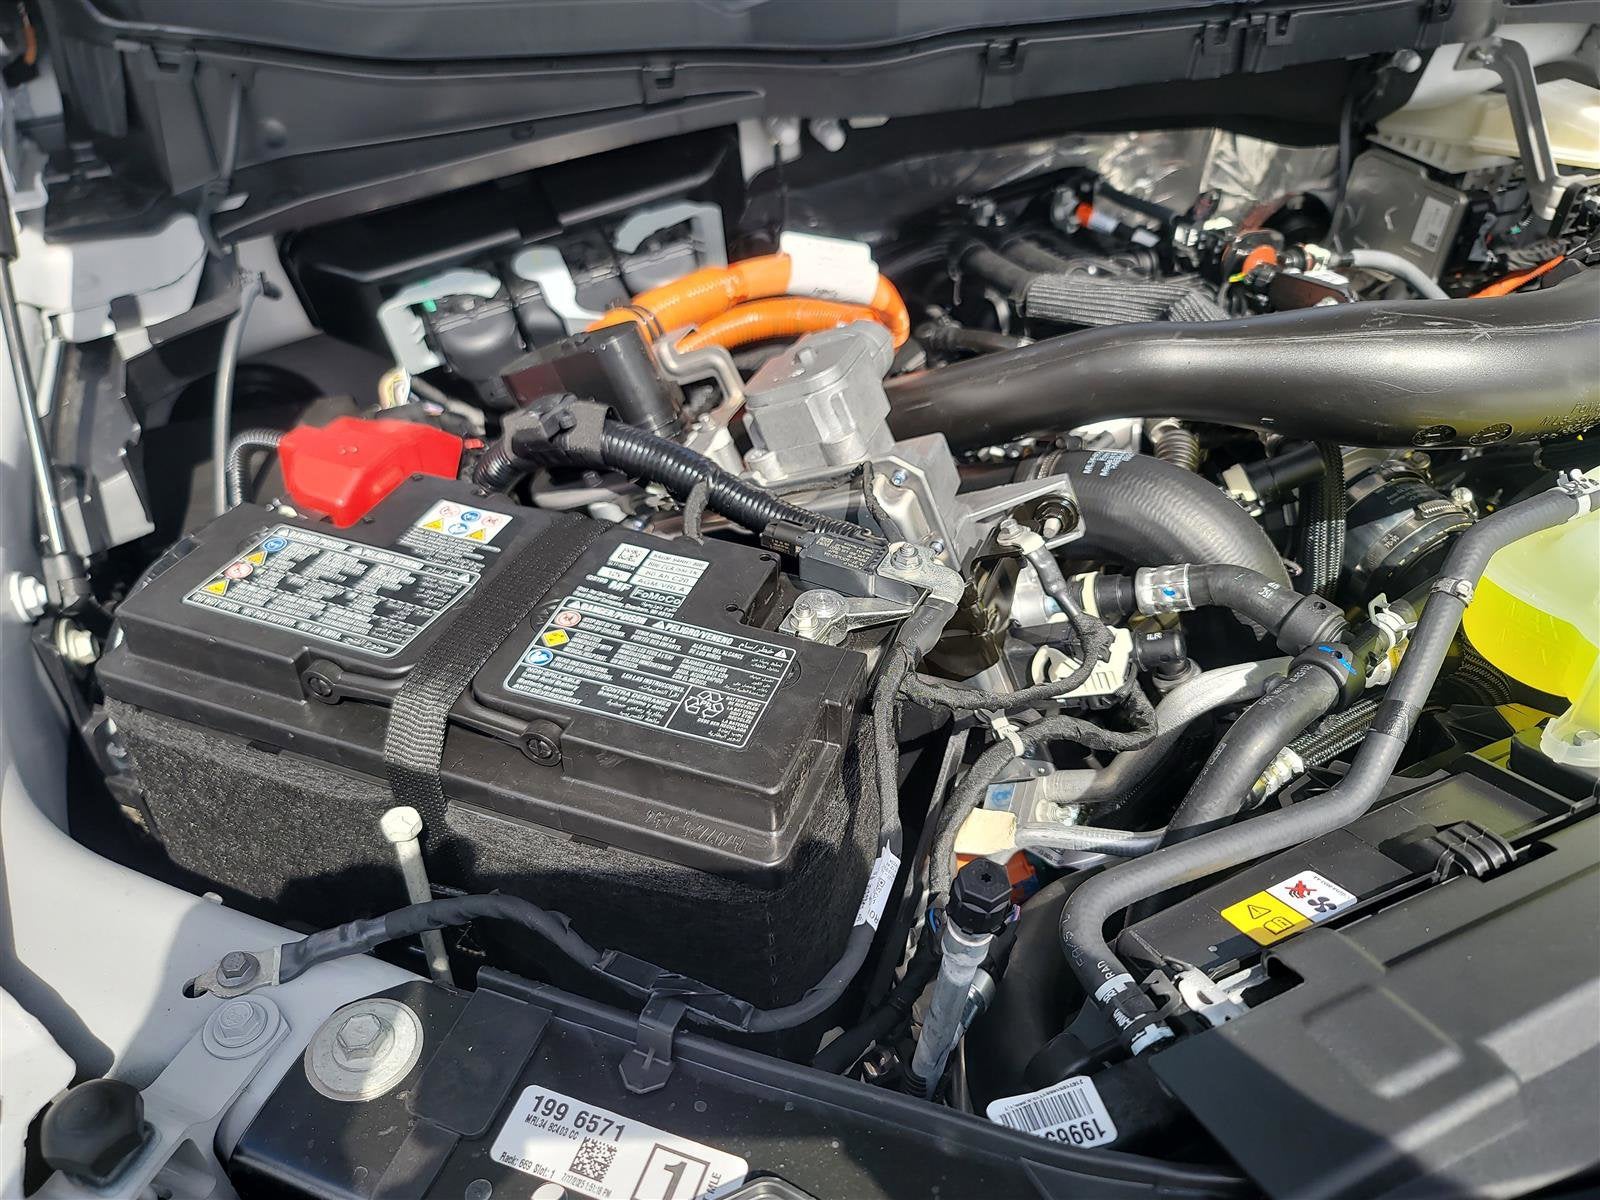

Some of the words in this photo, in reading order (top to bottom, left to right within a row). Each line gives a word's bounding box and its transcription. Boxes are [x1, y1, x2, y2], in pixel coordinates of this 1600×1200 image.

[632, 586, 682, 607] FoMoCo
[578, 602, 648, 625] DANGER/POISON
[663, 622, 734, 645] PELIGRO/VENENO
[1097, 960, 1115, 980] RAD
[532, 1095, 569, 1121] 199
[573, 1110, 625, 1142] 6571
[500, 1151, 518, 1166] Rack:
[519, 1159, 532, 1171] 669
[533, 1163, 550, 1178] Slot:
[663, 1161, 687, 1200] 1
